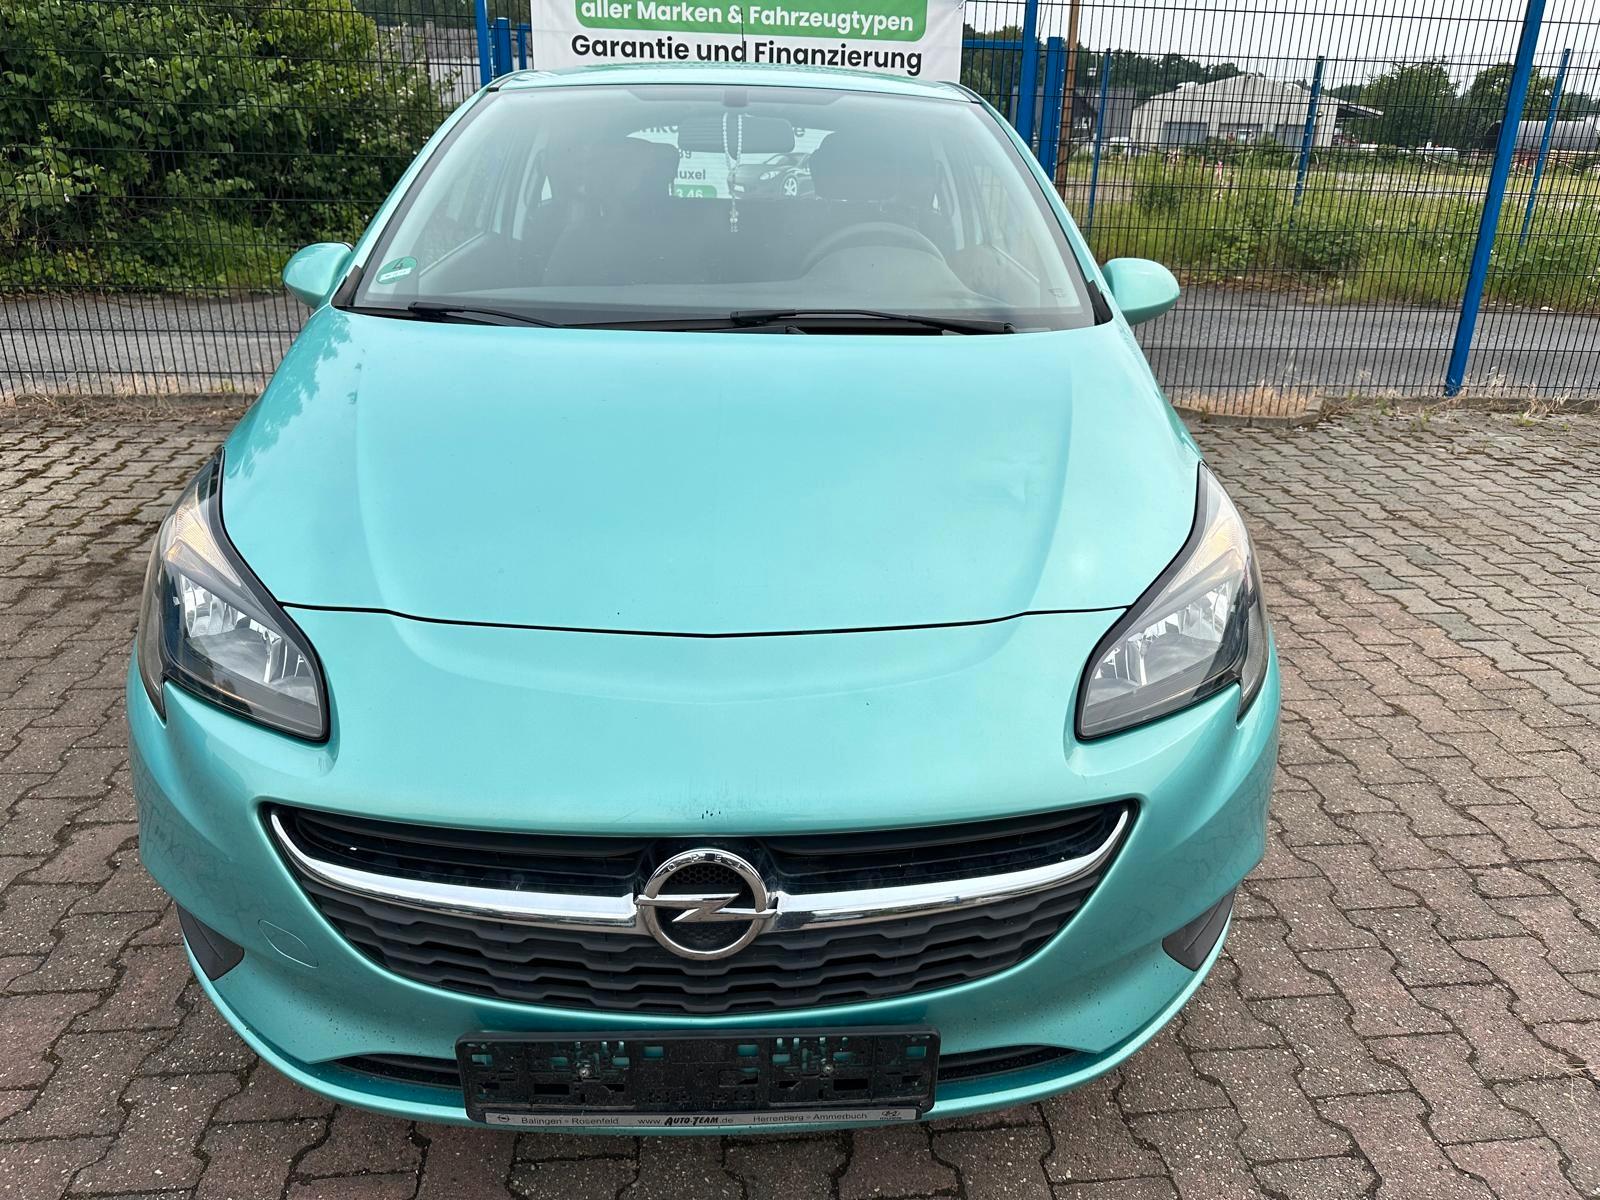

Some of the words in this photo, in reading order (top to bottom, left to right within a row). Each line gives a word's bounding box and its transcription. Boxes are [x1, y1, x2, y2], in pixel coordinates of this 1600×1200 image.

[581, 0, 632, 19] aller
[637, 1, 722, 22] Marken
[727, 5, 743, 24] &
[750, 6, 914, 36] Fahrzeugtypen
[571, 35, 690, 61] Garantie
[696, 40, 747, 63] und
[754, 40, 922, 77] Finanzierung
[679, 169, 706, 180] uxel
[521, 1117, 562, 1126] Balingen
[572, 1117, 619, 1125] Rosenfeld
[753, 1114, 804, 1123] Herrenberg
[814, 1112, 868, 1121] Ammerbuch
